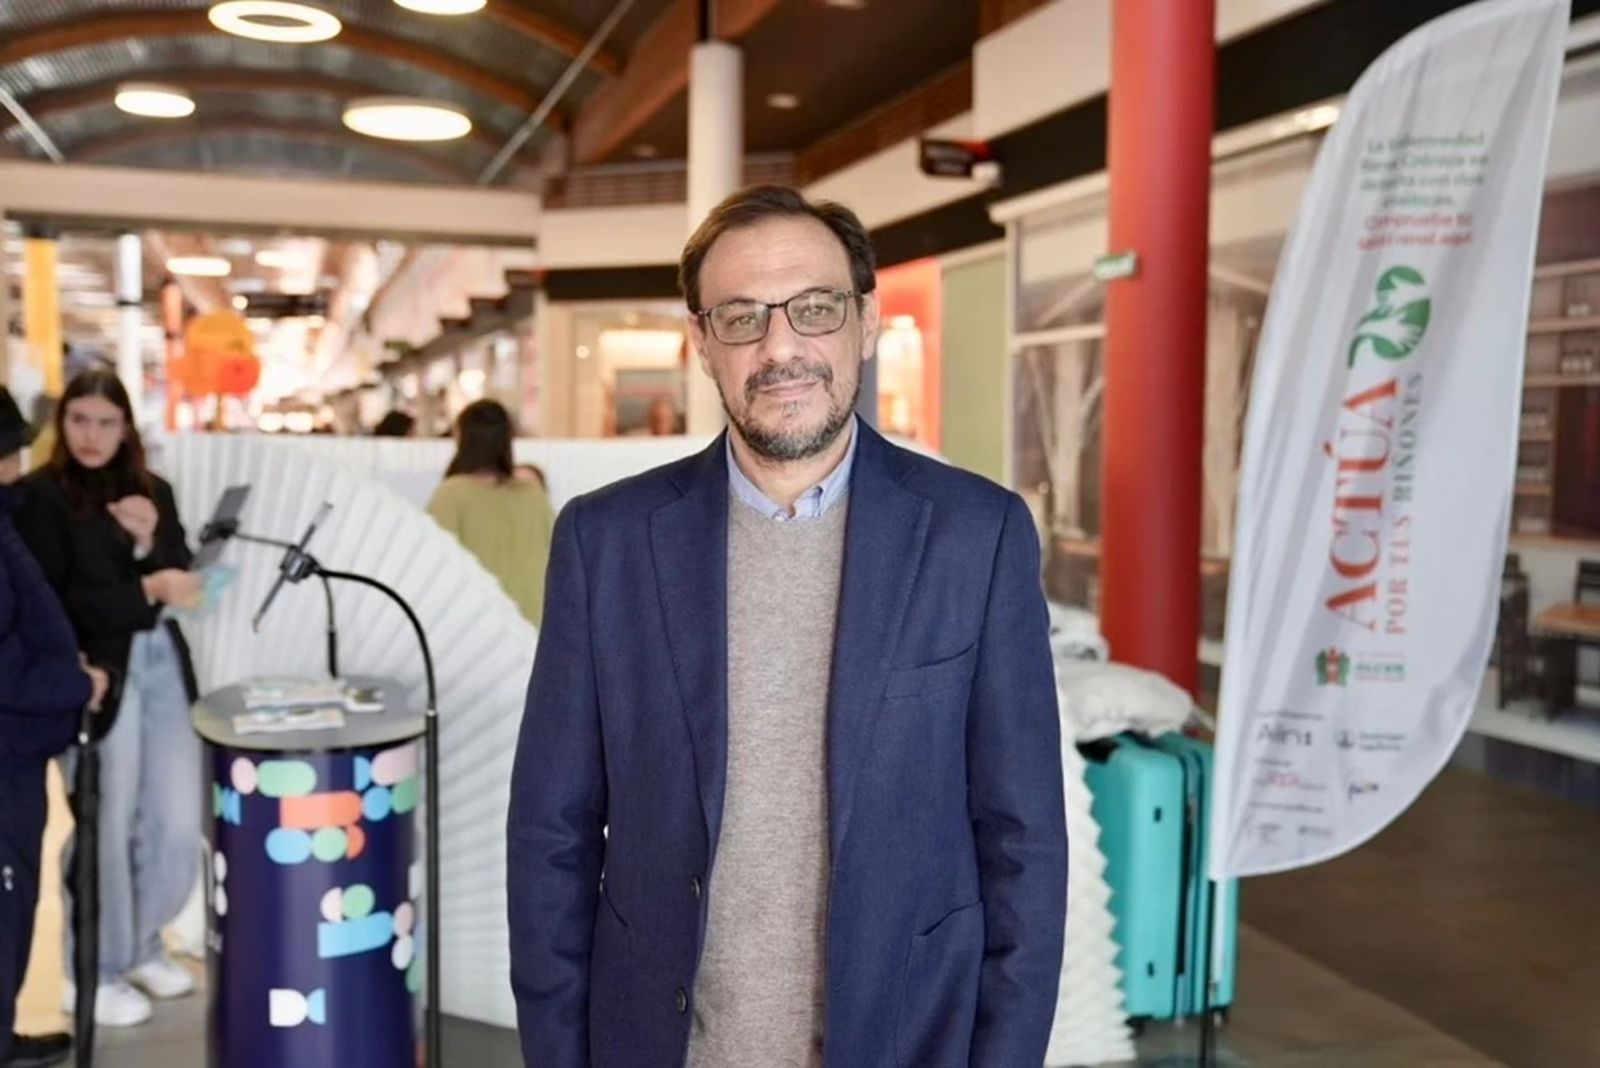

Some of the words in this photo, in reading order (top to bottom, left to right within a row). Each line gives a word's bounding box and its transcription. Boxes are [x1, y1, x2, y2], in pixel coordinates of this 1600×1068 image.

[1392, 372, 1423, 503] RIÑONES
[1322, 378, 1400, 632] ACTÚA
[1389, 514, 1412, 567] TUS
[1386, 578, 1409, 635] POR
